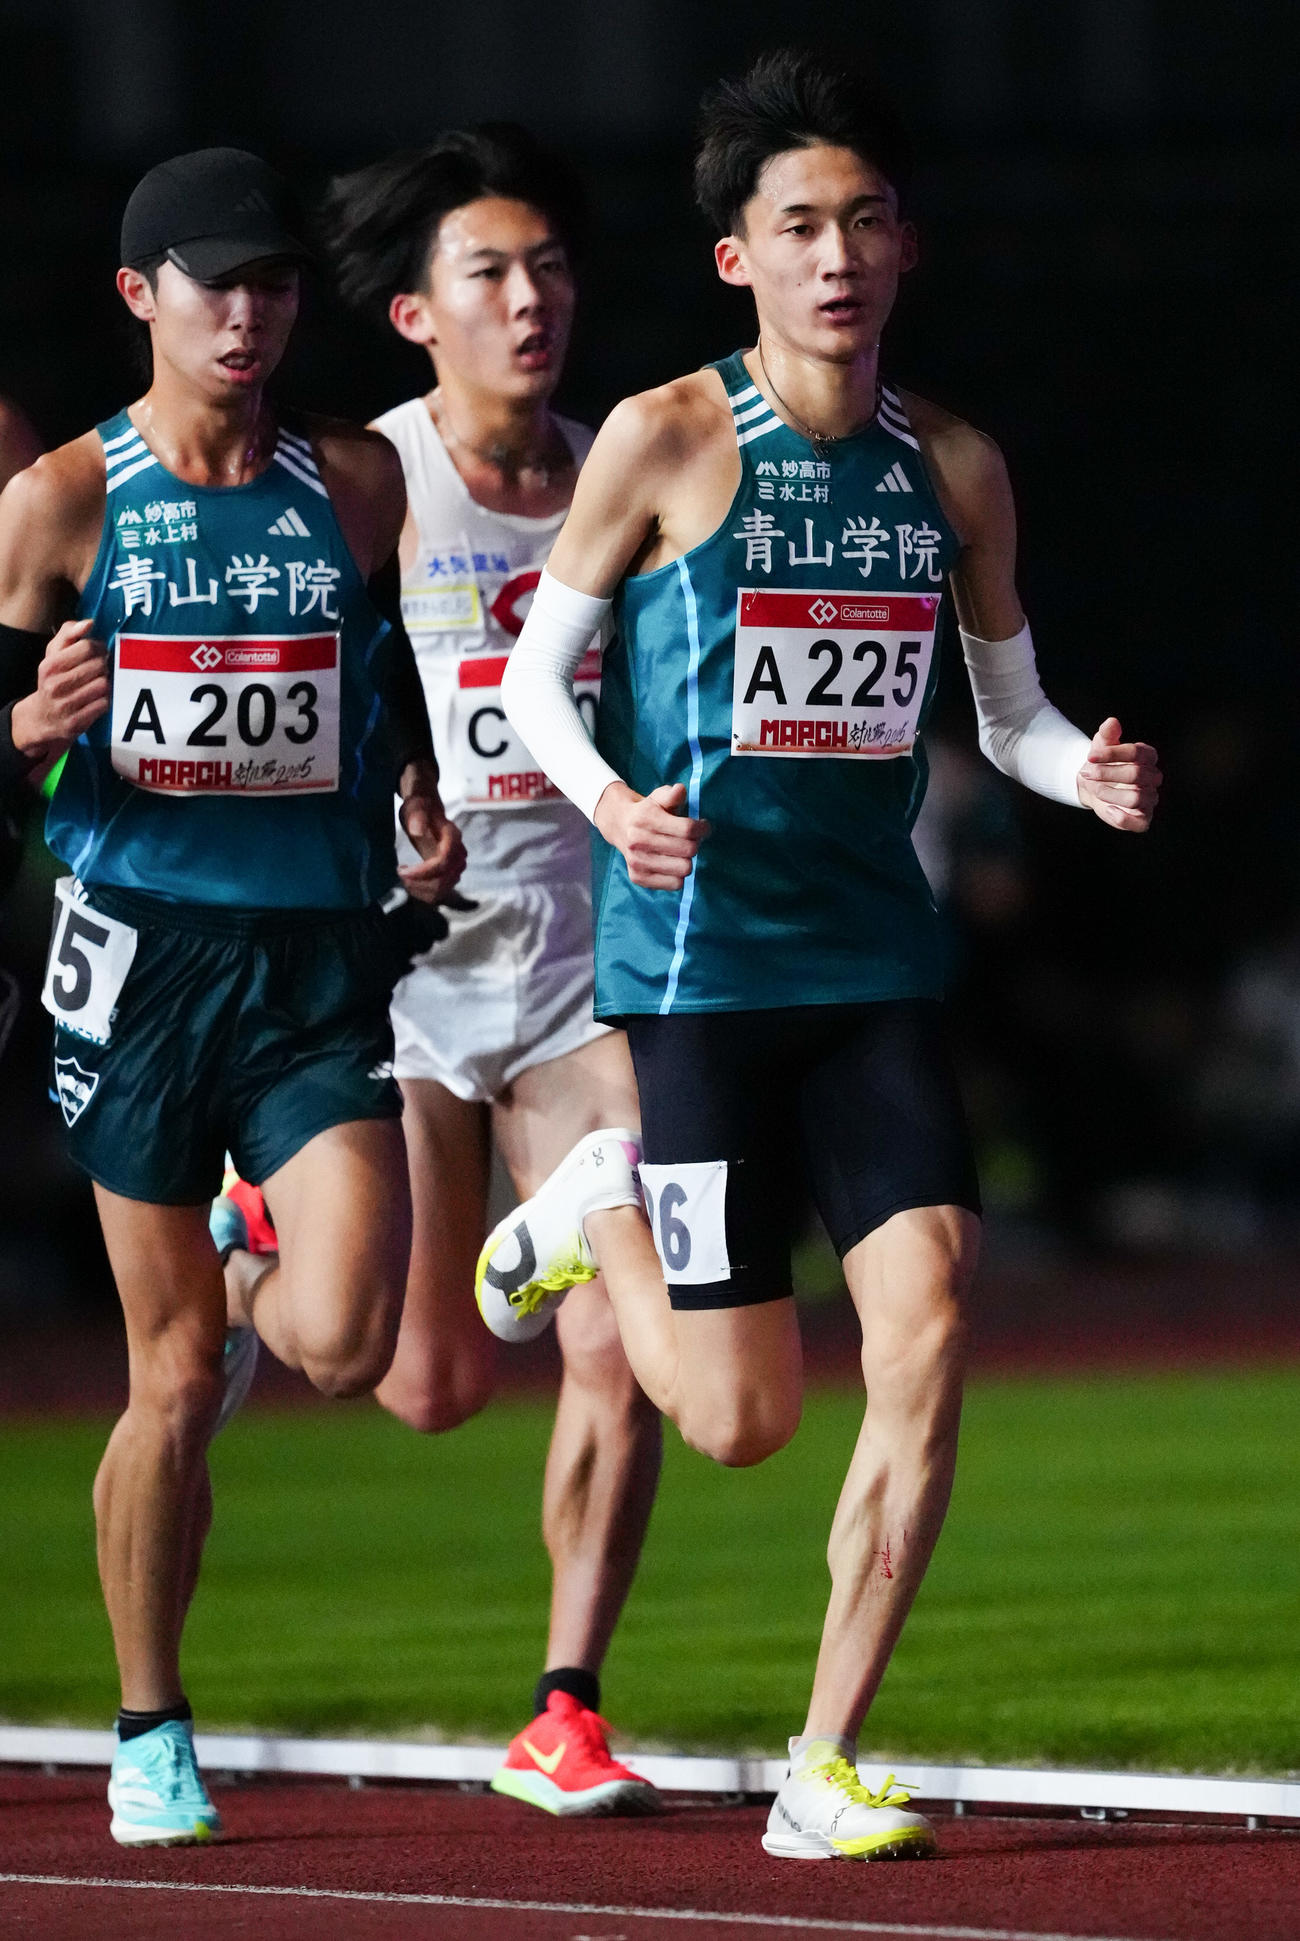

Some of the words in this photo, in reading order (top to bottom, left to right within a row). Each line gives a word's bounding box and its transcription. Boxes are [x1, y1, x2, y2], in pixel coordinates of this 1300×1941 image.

[781, 460, 831, 479] 妙高市
[779, 483, 830, 503] 水上村
[144, 500, 197, 524] 妙高市
[144, 523, 198, 546] 水上村
[733, 507, 943, 583] 青山学院
[108, 554, 341, 619] 青山学院
[743, 645, 788, 705] A
[805, 639, 922, 708] 225
[121, 688, 167, 745] A
[186, 681, 319, 747] 203
[468, 707, 509, 758] C
[760, 719, 848, 747] MARCH
[138, 758, 232, 786] MARCH
[487, 771, 562, 800] MAR
